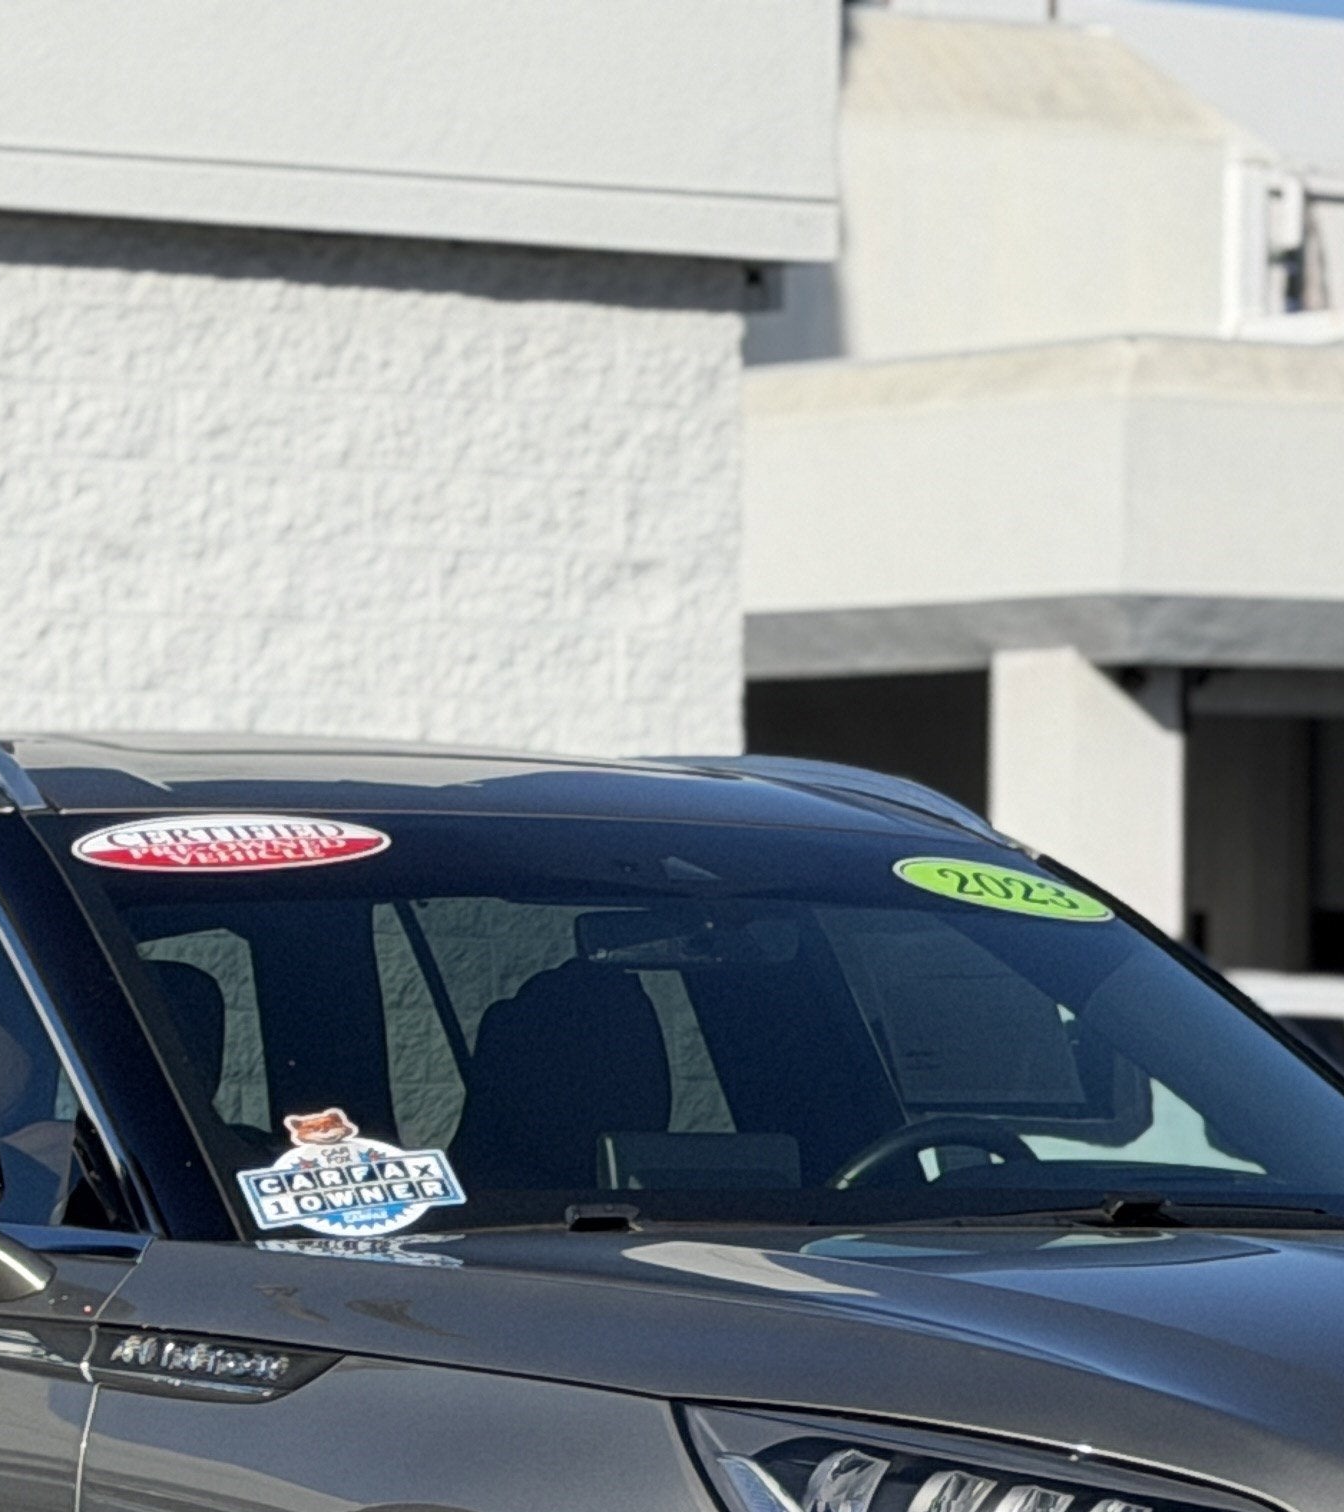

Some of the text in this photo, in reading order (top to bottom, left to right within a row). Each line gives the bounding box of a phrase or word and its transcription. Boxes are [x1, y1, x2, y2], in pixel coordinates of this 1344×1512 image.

[107, 823, 345, 848] CERTIFIED
[165, 846, 327, 865] VEHICLE
[937, 867, 1080, 910] 2023
[258, 1162, 433, 1195] CARFAX
[270, 1180, 445, 1216] 1 OWNER
